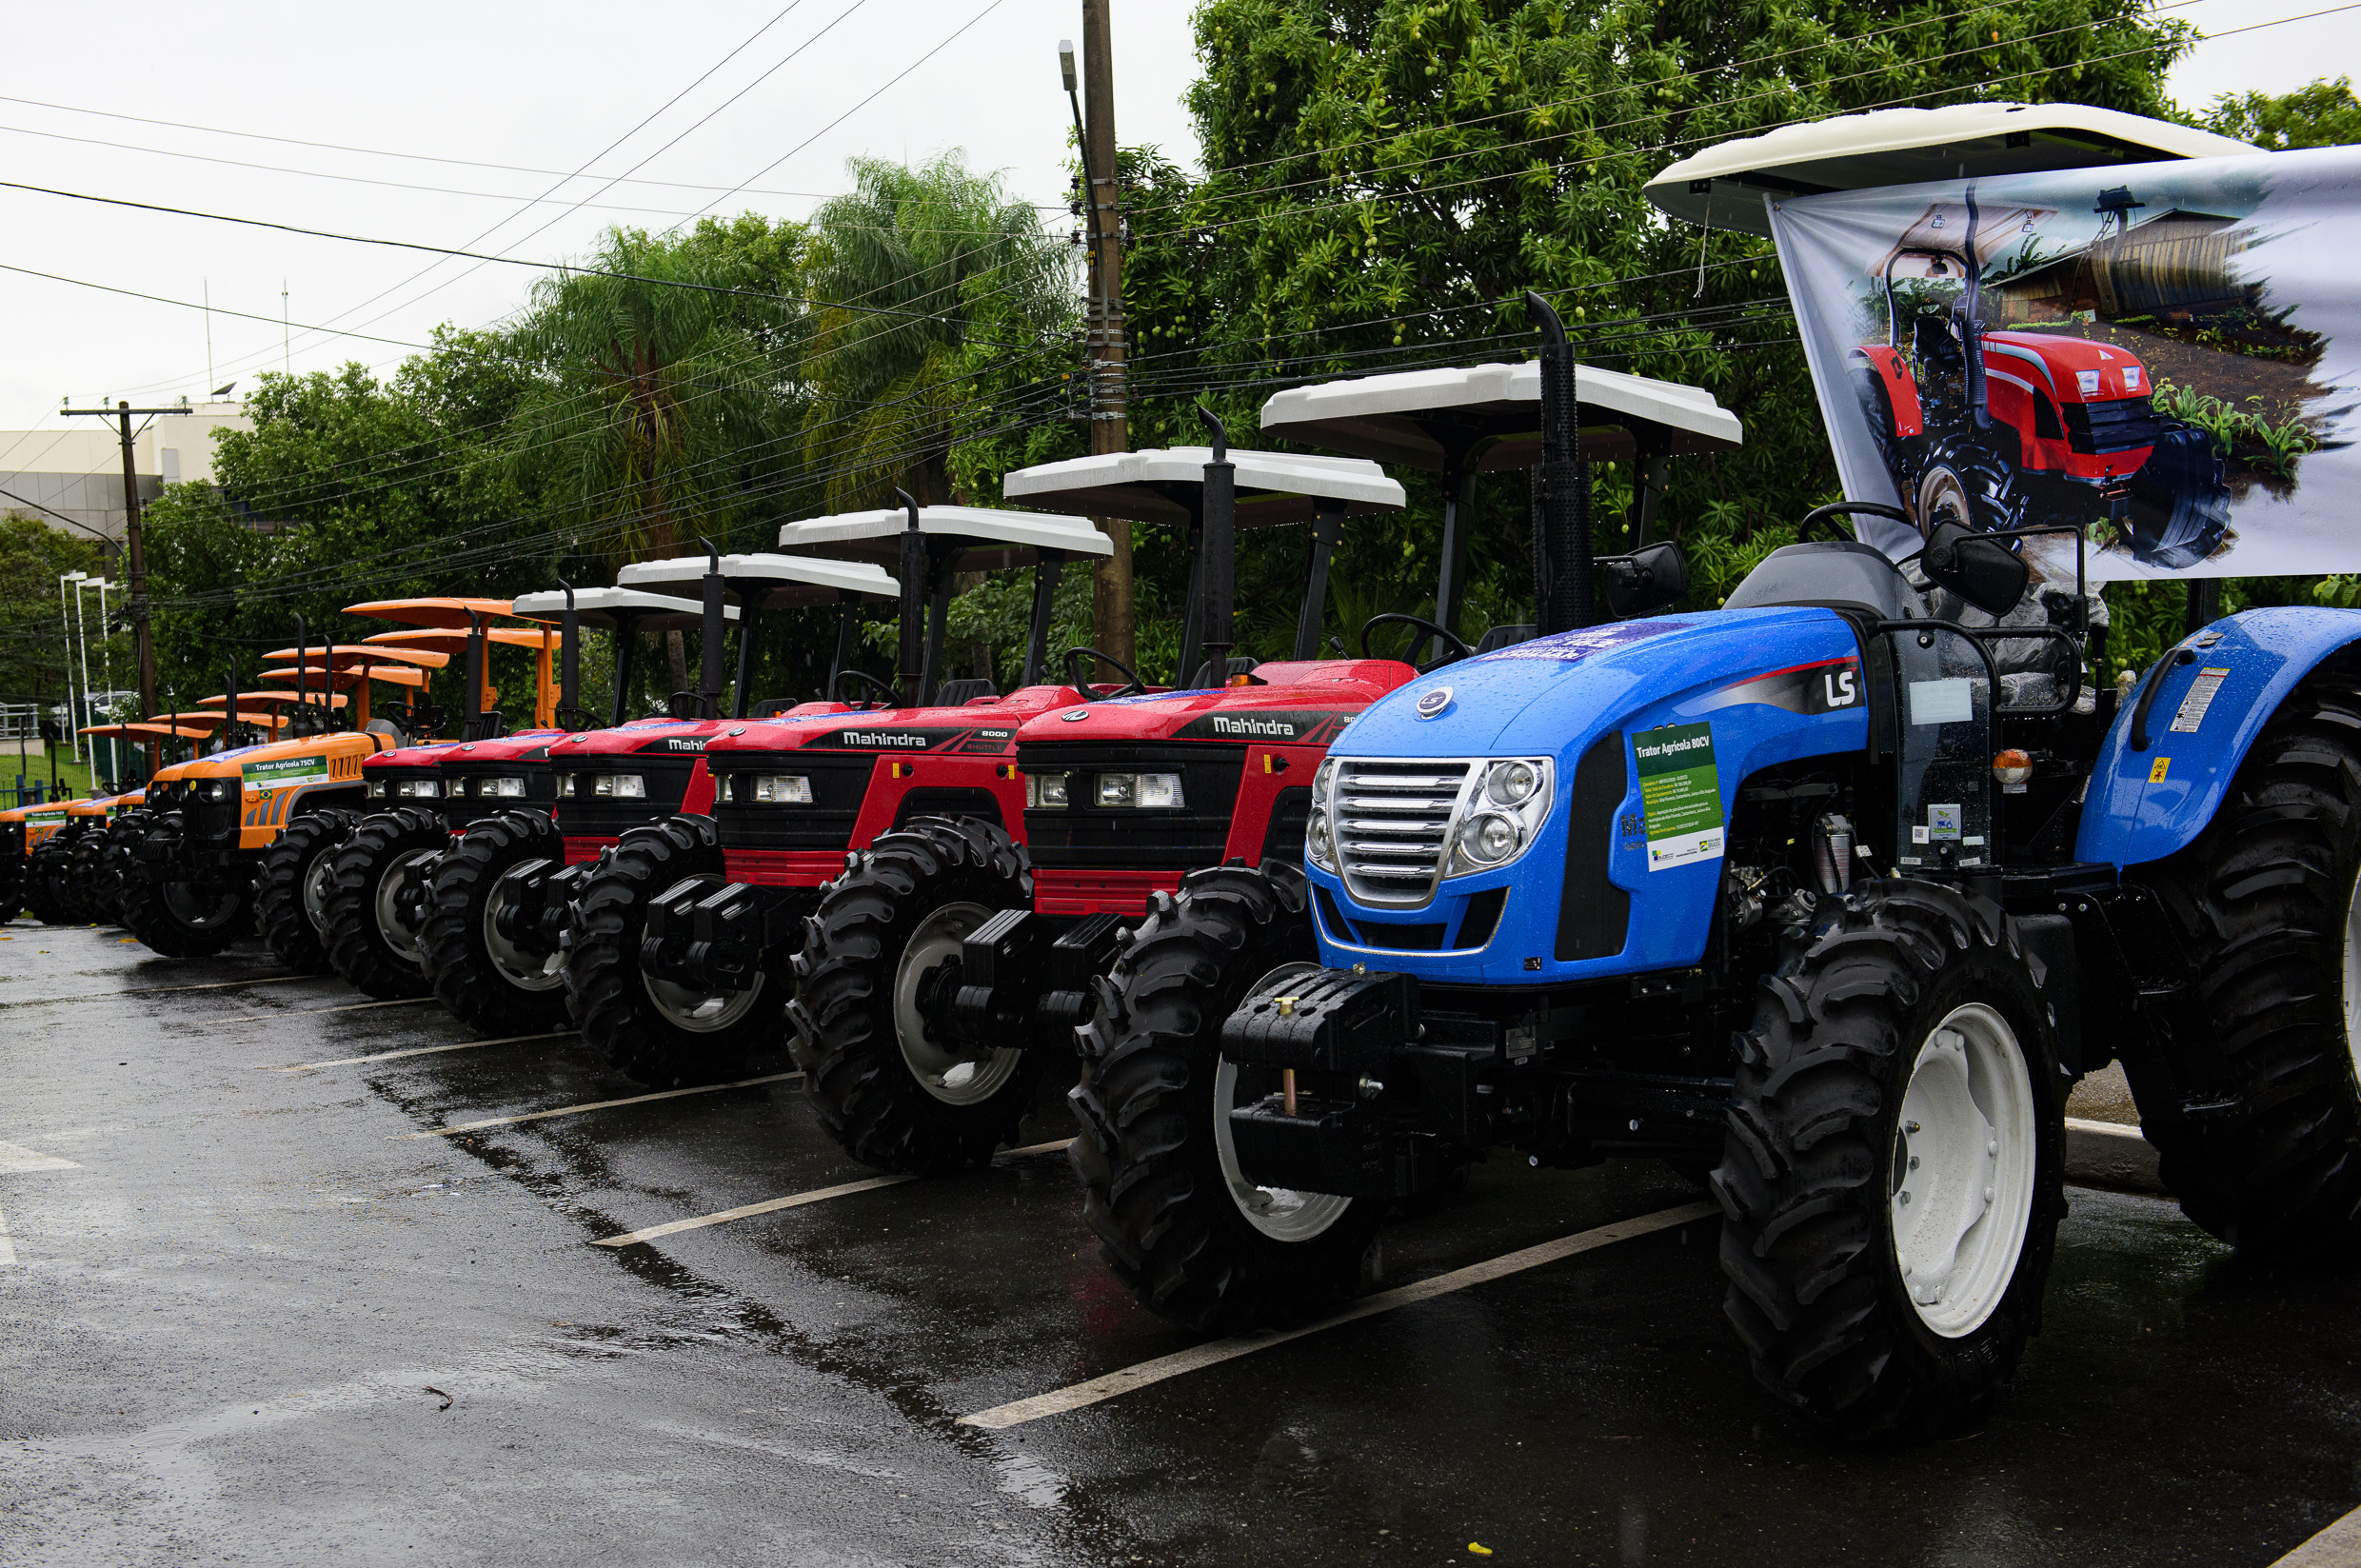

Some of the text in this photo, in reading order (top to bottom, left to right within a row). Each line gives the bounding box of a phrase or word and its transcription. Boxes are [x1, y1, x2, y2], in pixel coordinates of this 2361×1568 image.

[1825, 670, 1856, 707] LS
[1420, 696, 1442, 705] LS
[1214, 717, 1295, 736] Mahindra
[843, 731, 926, 746] Mahindra
[1637, 735, 1710, 759] Trator Agrícola 80CV
[275, 761, 300, 770] Agrícola
[300, 758, 315, 766] 75CV
